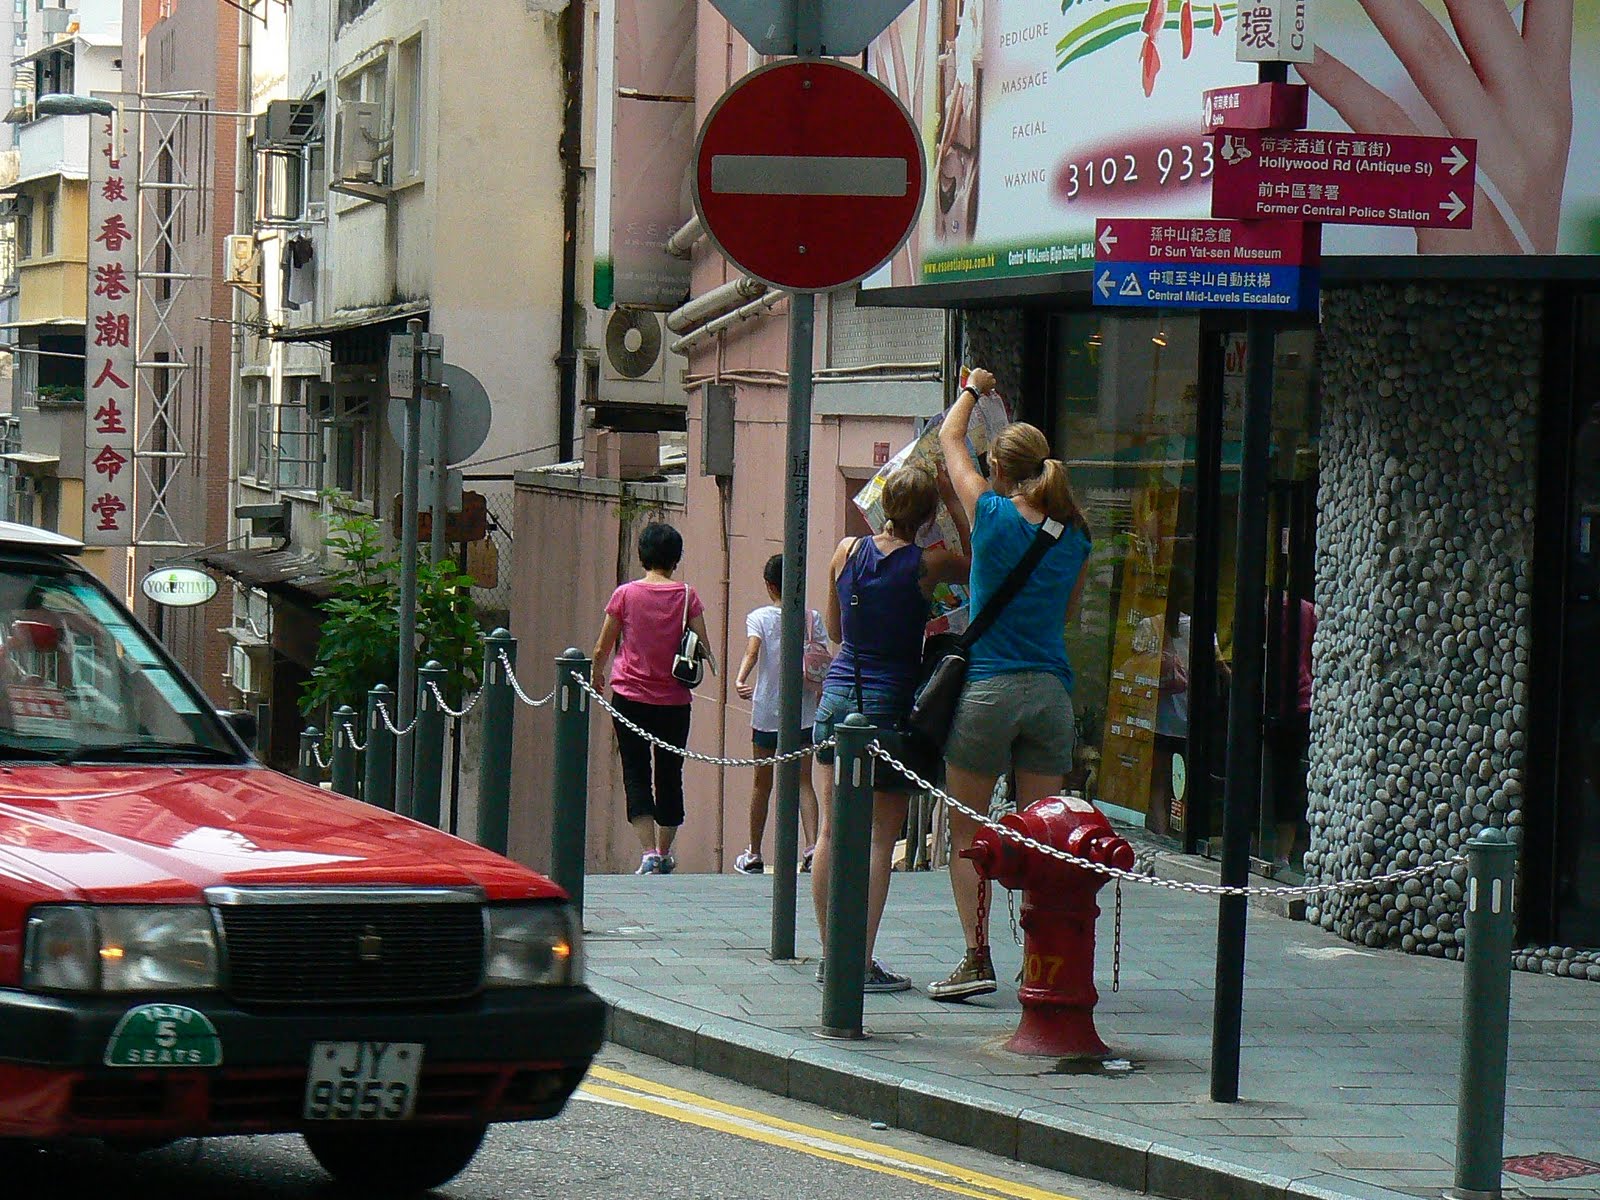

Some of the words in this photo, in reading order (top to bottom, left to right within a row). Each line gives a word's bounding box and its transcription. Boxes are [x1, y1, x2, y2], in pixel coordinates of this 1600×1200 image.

[1241, 0, 1275, 48] 環
[1291, 0, 1305, 51] Cen
[1000, 22, 1048, 47] PEDICURE
[1001, 71, 1048, 94] MASSAGE
[1012, 121, 1047, 139] FACIAL
[1259, 156, 1329, 171] Hollywood
[1332, 159, 1351, 171] Rd
[1356, 160, 1412, 175] (Antique
[1414, 161, 1433, 176] St)
[1004, 169, 1046, 188] WAXING
[1067, 155, 1138, 197] 3102
[1258, 182, 1340, 200] 前中區警署
[1256, 202, 1299, 215] Former
[1302, 204, 1346, 217] Central
[1349, 206, 1386, 219] Police
[1388, 207, 1430, 221] Station
[1150, 226, 1232, 243] 孫中山紀念館
[1149, 245, 1163, 257] Dr
[1165, 246, 1187, 257] Sun
[1189, 246, 1231, 259] Yat-sen
[1233, 247, 1282, 259] Museum
[1149, 270, 1271, 288] 中環至半山自動扶梯
[1147, 289, 1183, 301] Central
[1185, 290, 1240, 303] Mid-Levels
[1243, 292, 1291, 304] Escalator
[1024, 954, 1064, 985] 07
[154, 1021, 178, 1048] 5
[127, 1048, 201, 1063] SEATS
[340, 1041, 391, 1079] JY
